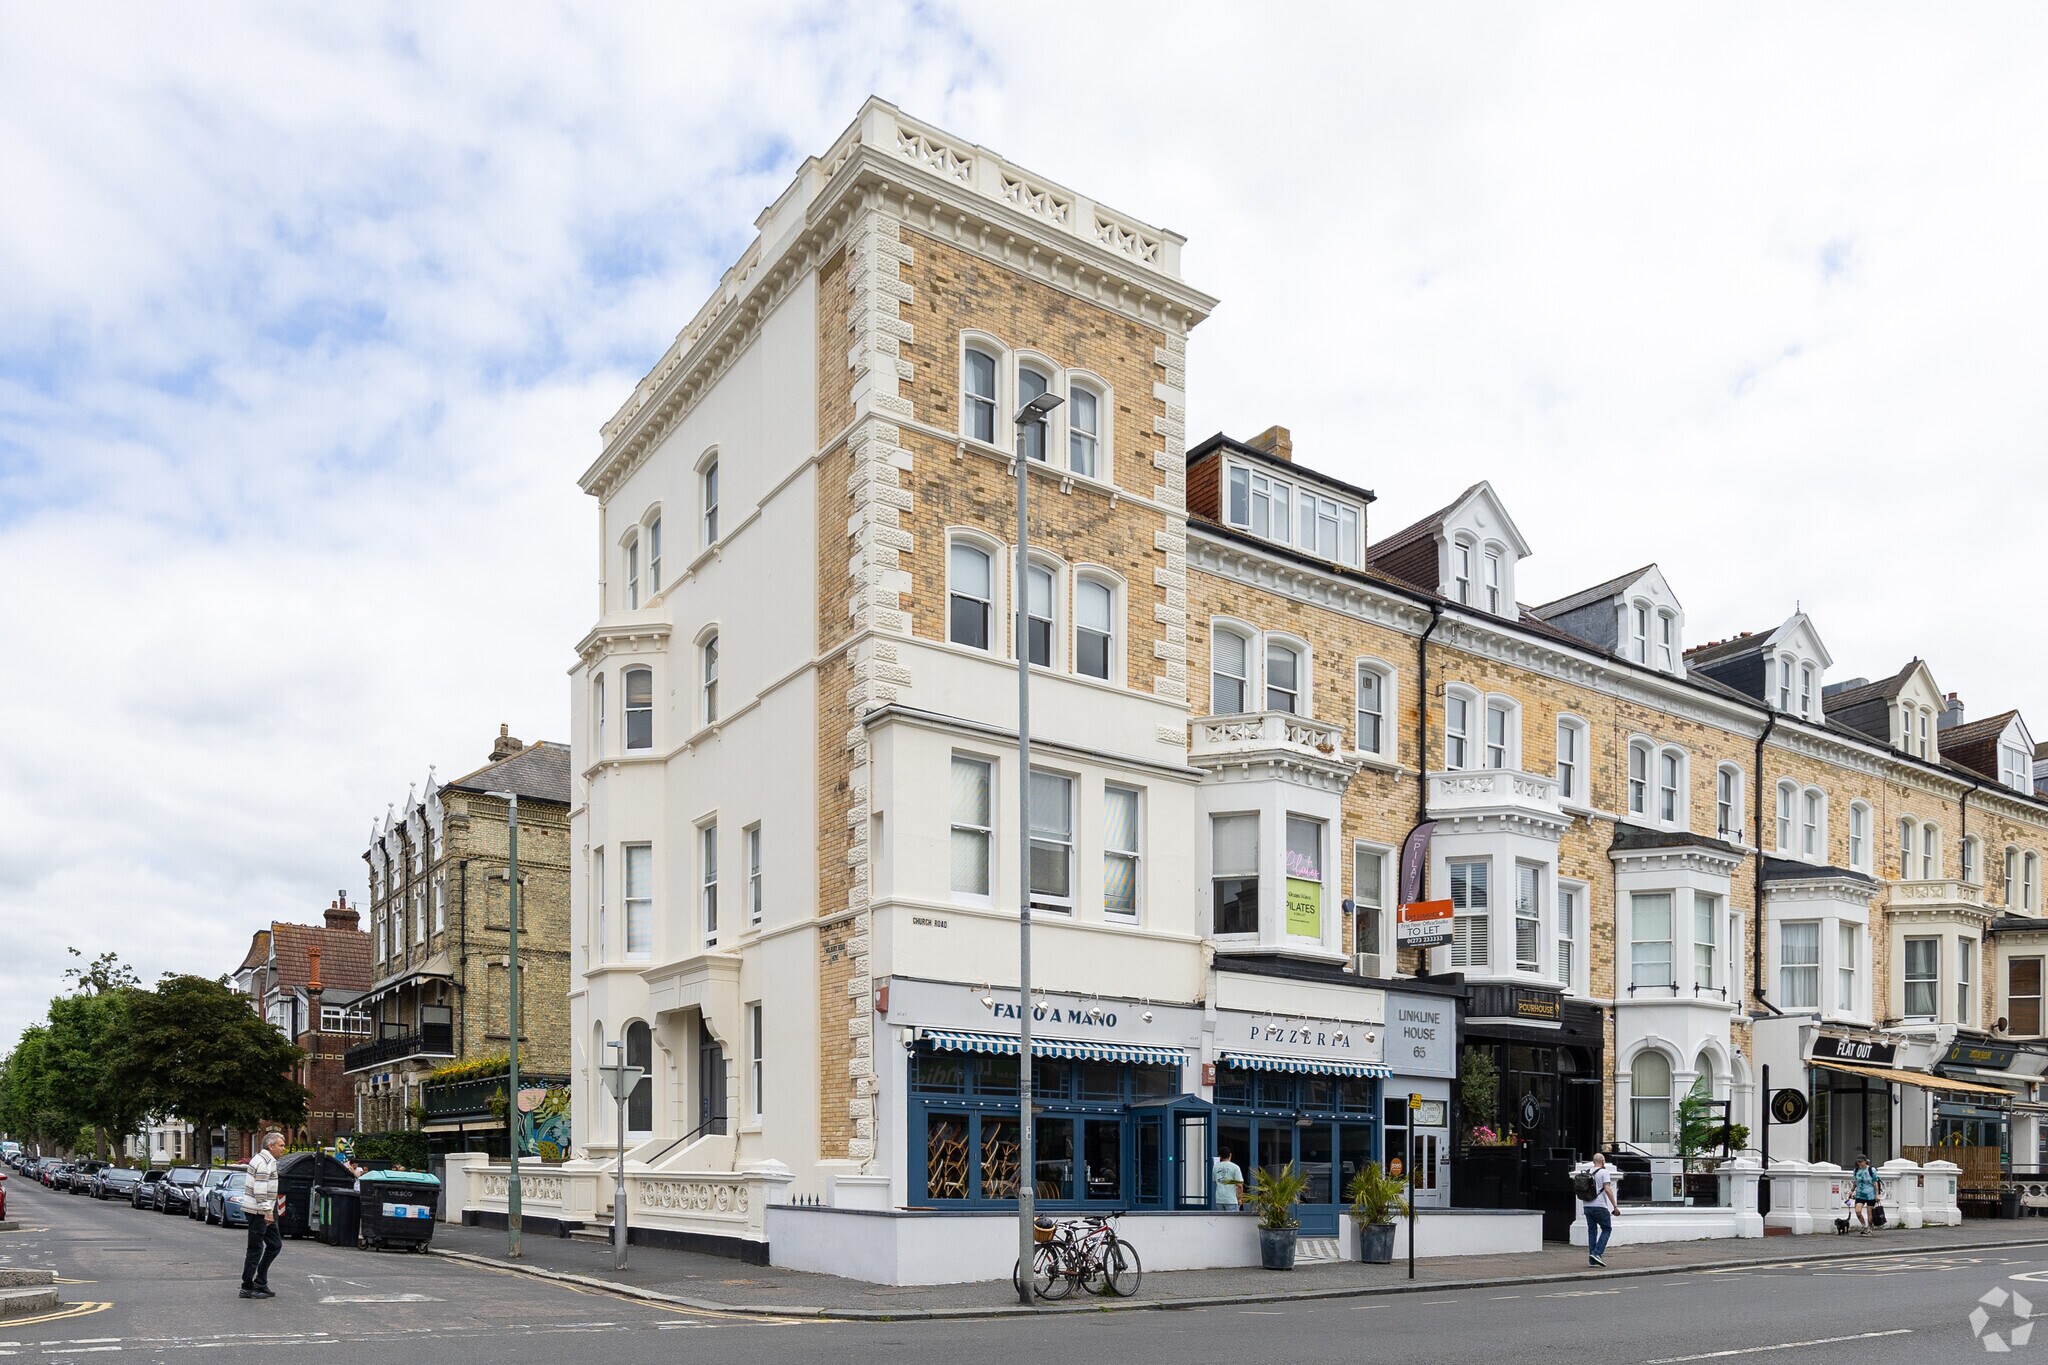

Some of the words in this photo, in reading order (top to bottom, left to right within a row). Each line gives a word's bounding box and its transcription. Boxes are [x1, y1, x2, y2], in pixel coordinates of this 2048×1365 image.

[912, 917, 931, 926] CHURCH
[934, 919, 947, 928] ROAD
[1407, 928, 1421, 936] TO
[1423, 926, 1440, 935] LET
[993, 1003, 1045, 1021] FATO
[1050, 1008, 1062, 1022] A
[1068, 1009, 1117, 1027] MANO
[1398, 1009, 1441, 1024] LINKLINE
[1250, 1027, 1350, 1048] PIZZERIA
[1403, 1026, 1436, 1040] HOUSE
[1413, 1046, 1426, 1058] 65
[1836, 1041, 1856, 1056] FLAT
[1856, 1044, 1873, 1059] OUT
